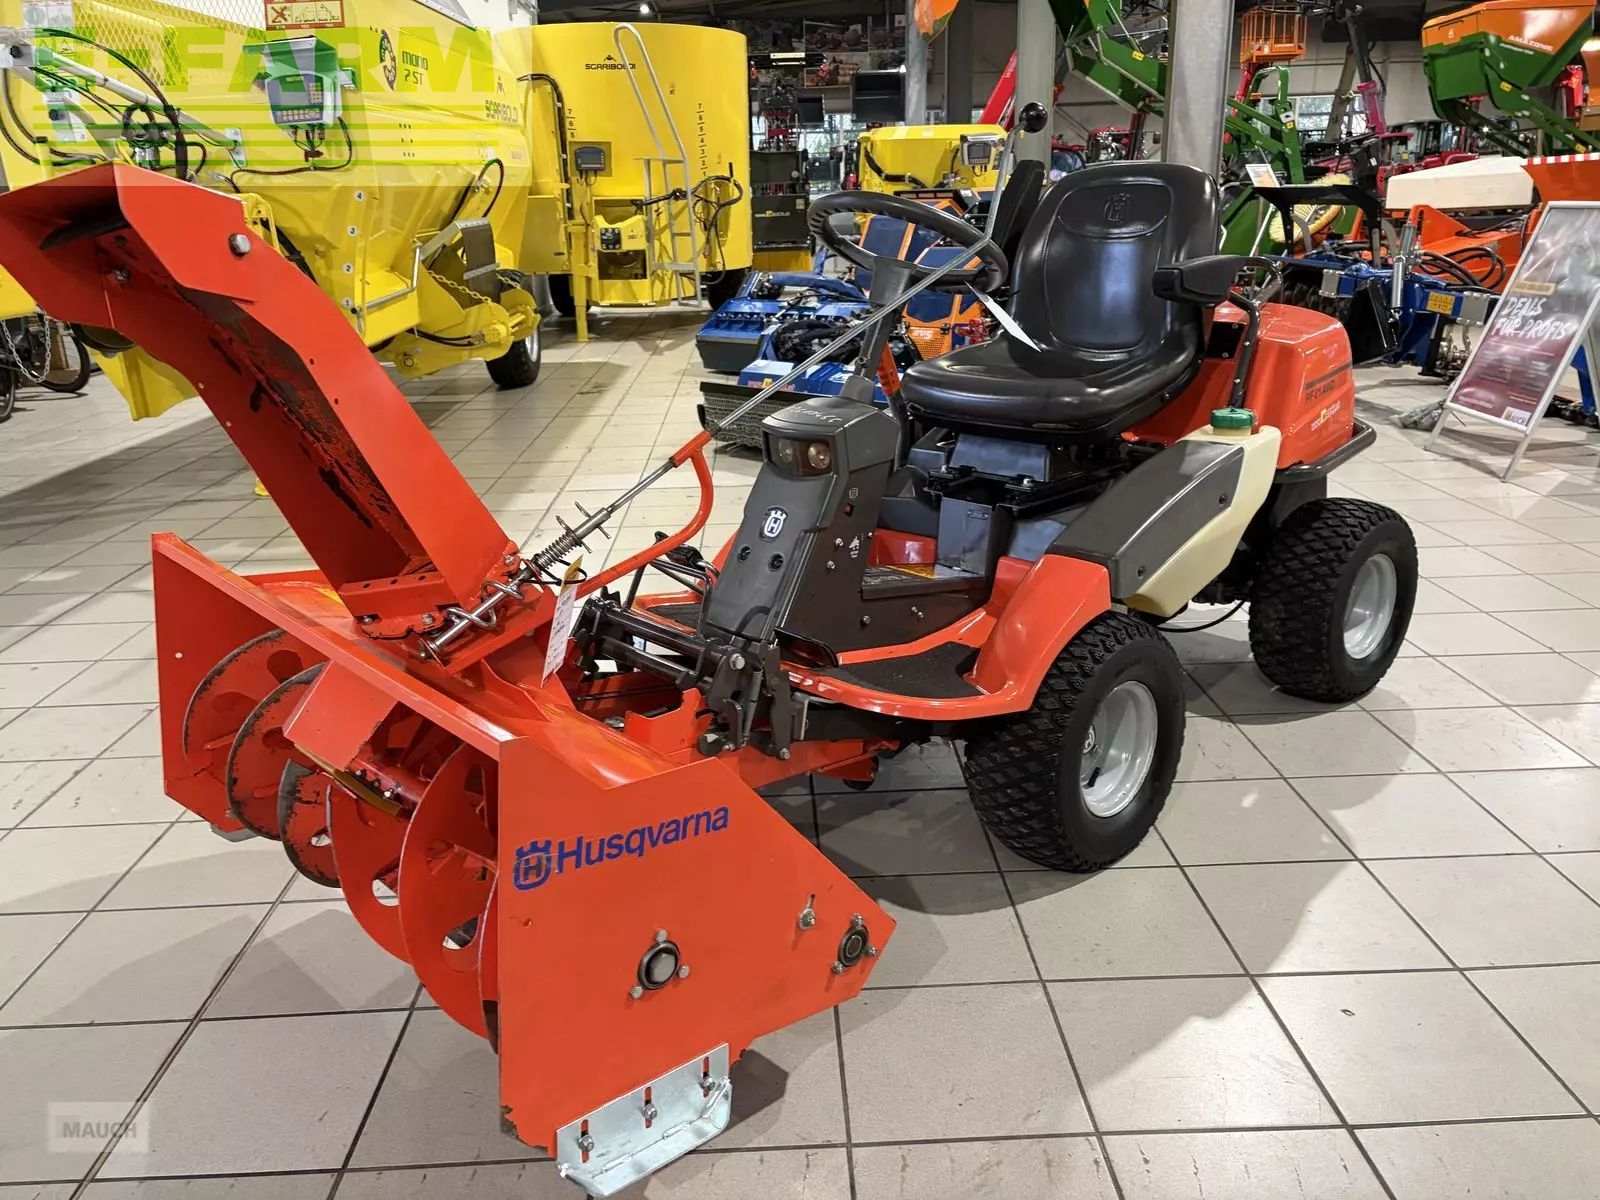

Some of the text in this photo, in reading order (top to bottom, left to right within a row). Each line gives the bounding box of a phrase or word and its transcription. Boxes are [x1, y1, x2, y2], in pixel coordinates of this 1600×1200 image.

[1508, 35, 1554, 52] AMAZONE
[1500, 297, 1546, 316] DEALS
[557, 806, 729, 874] Husqvarna
